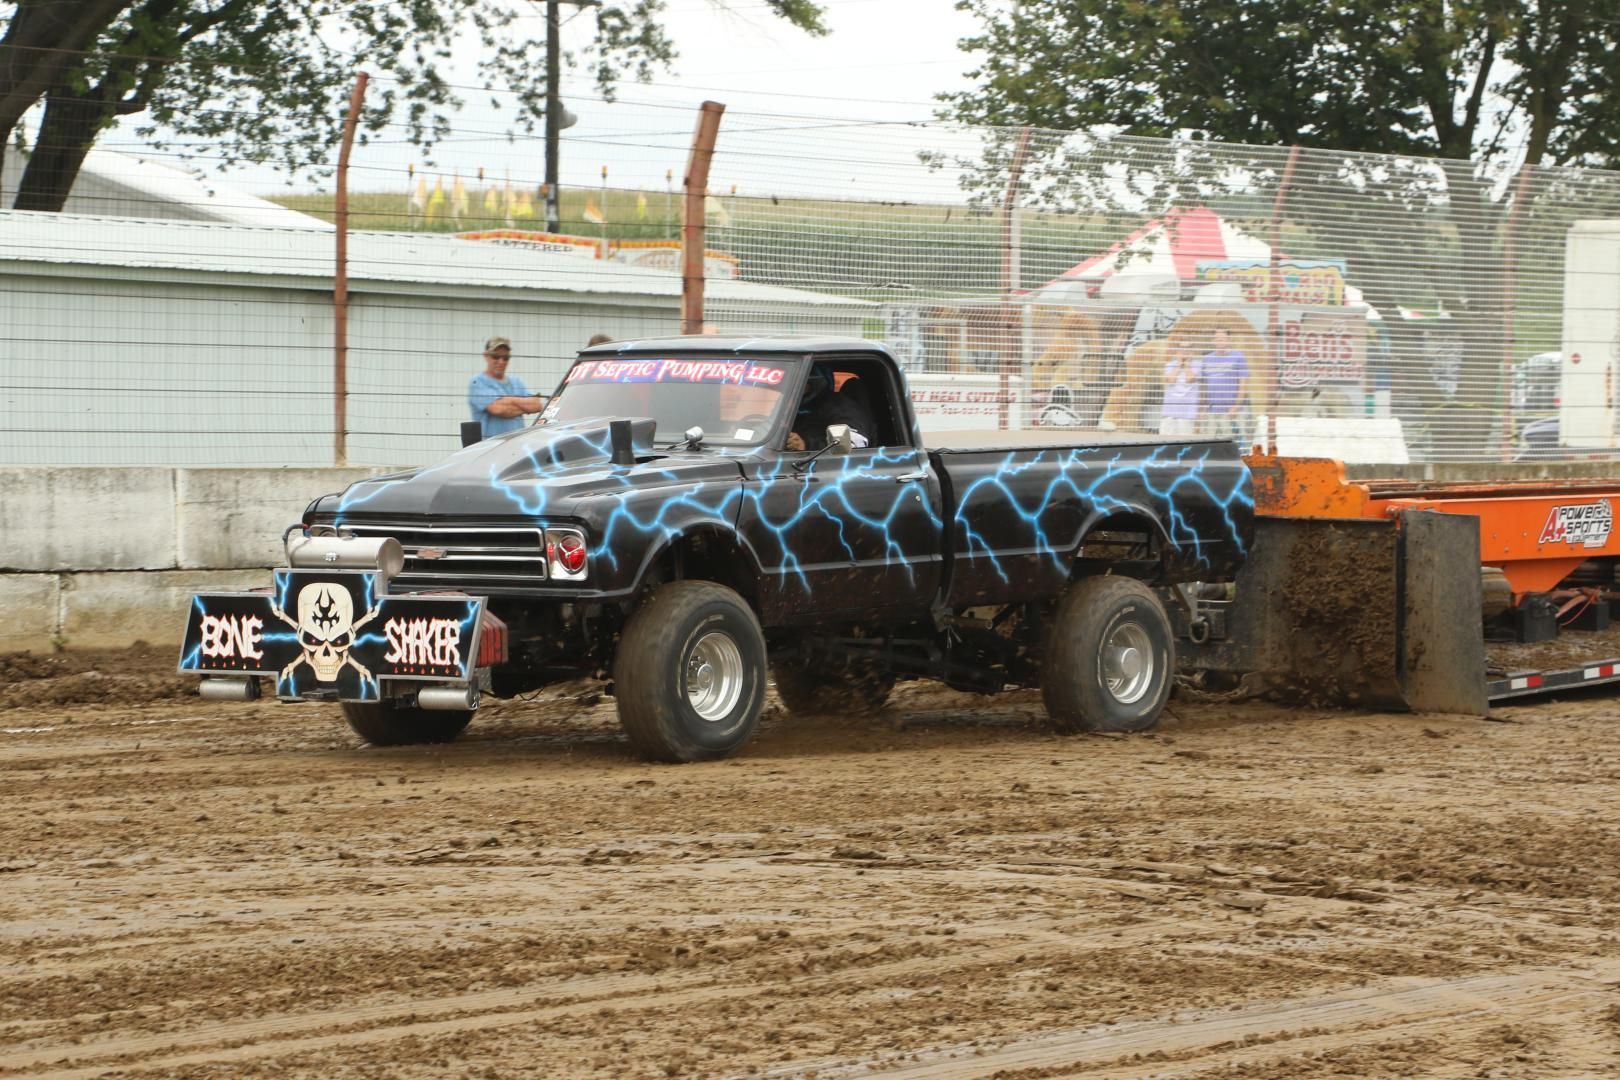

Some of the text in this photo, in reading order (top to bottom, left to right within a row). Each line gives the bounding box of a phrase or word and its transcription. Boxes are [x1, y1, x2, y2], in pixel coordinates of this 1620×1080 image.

[592, 360, 657, 380] SEPTIC
[656, 358, 748, 383] PUMPING
[745, 364, 785, 385] LLC
[965, 391, 1017, 403] CUTTIG
[1566, 520, 1610, 535] SPORTS
[200, 614, 463, 666] BONE SHAKER
